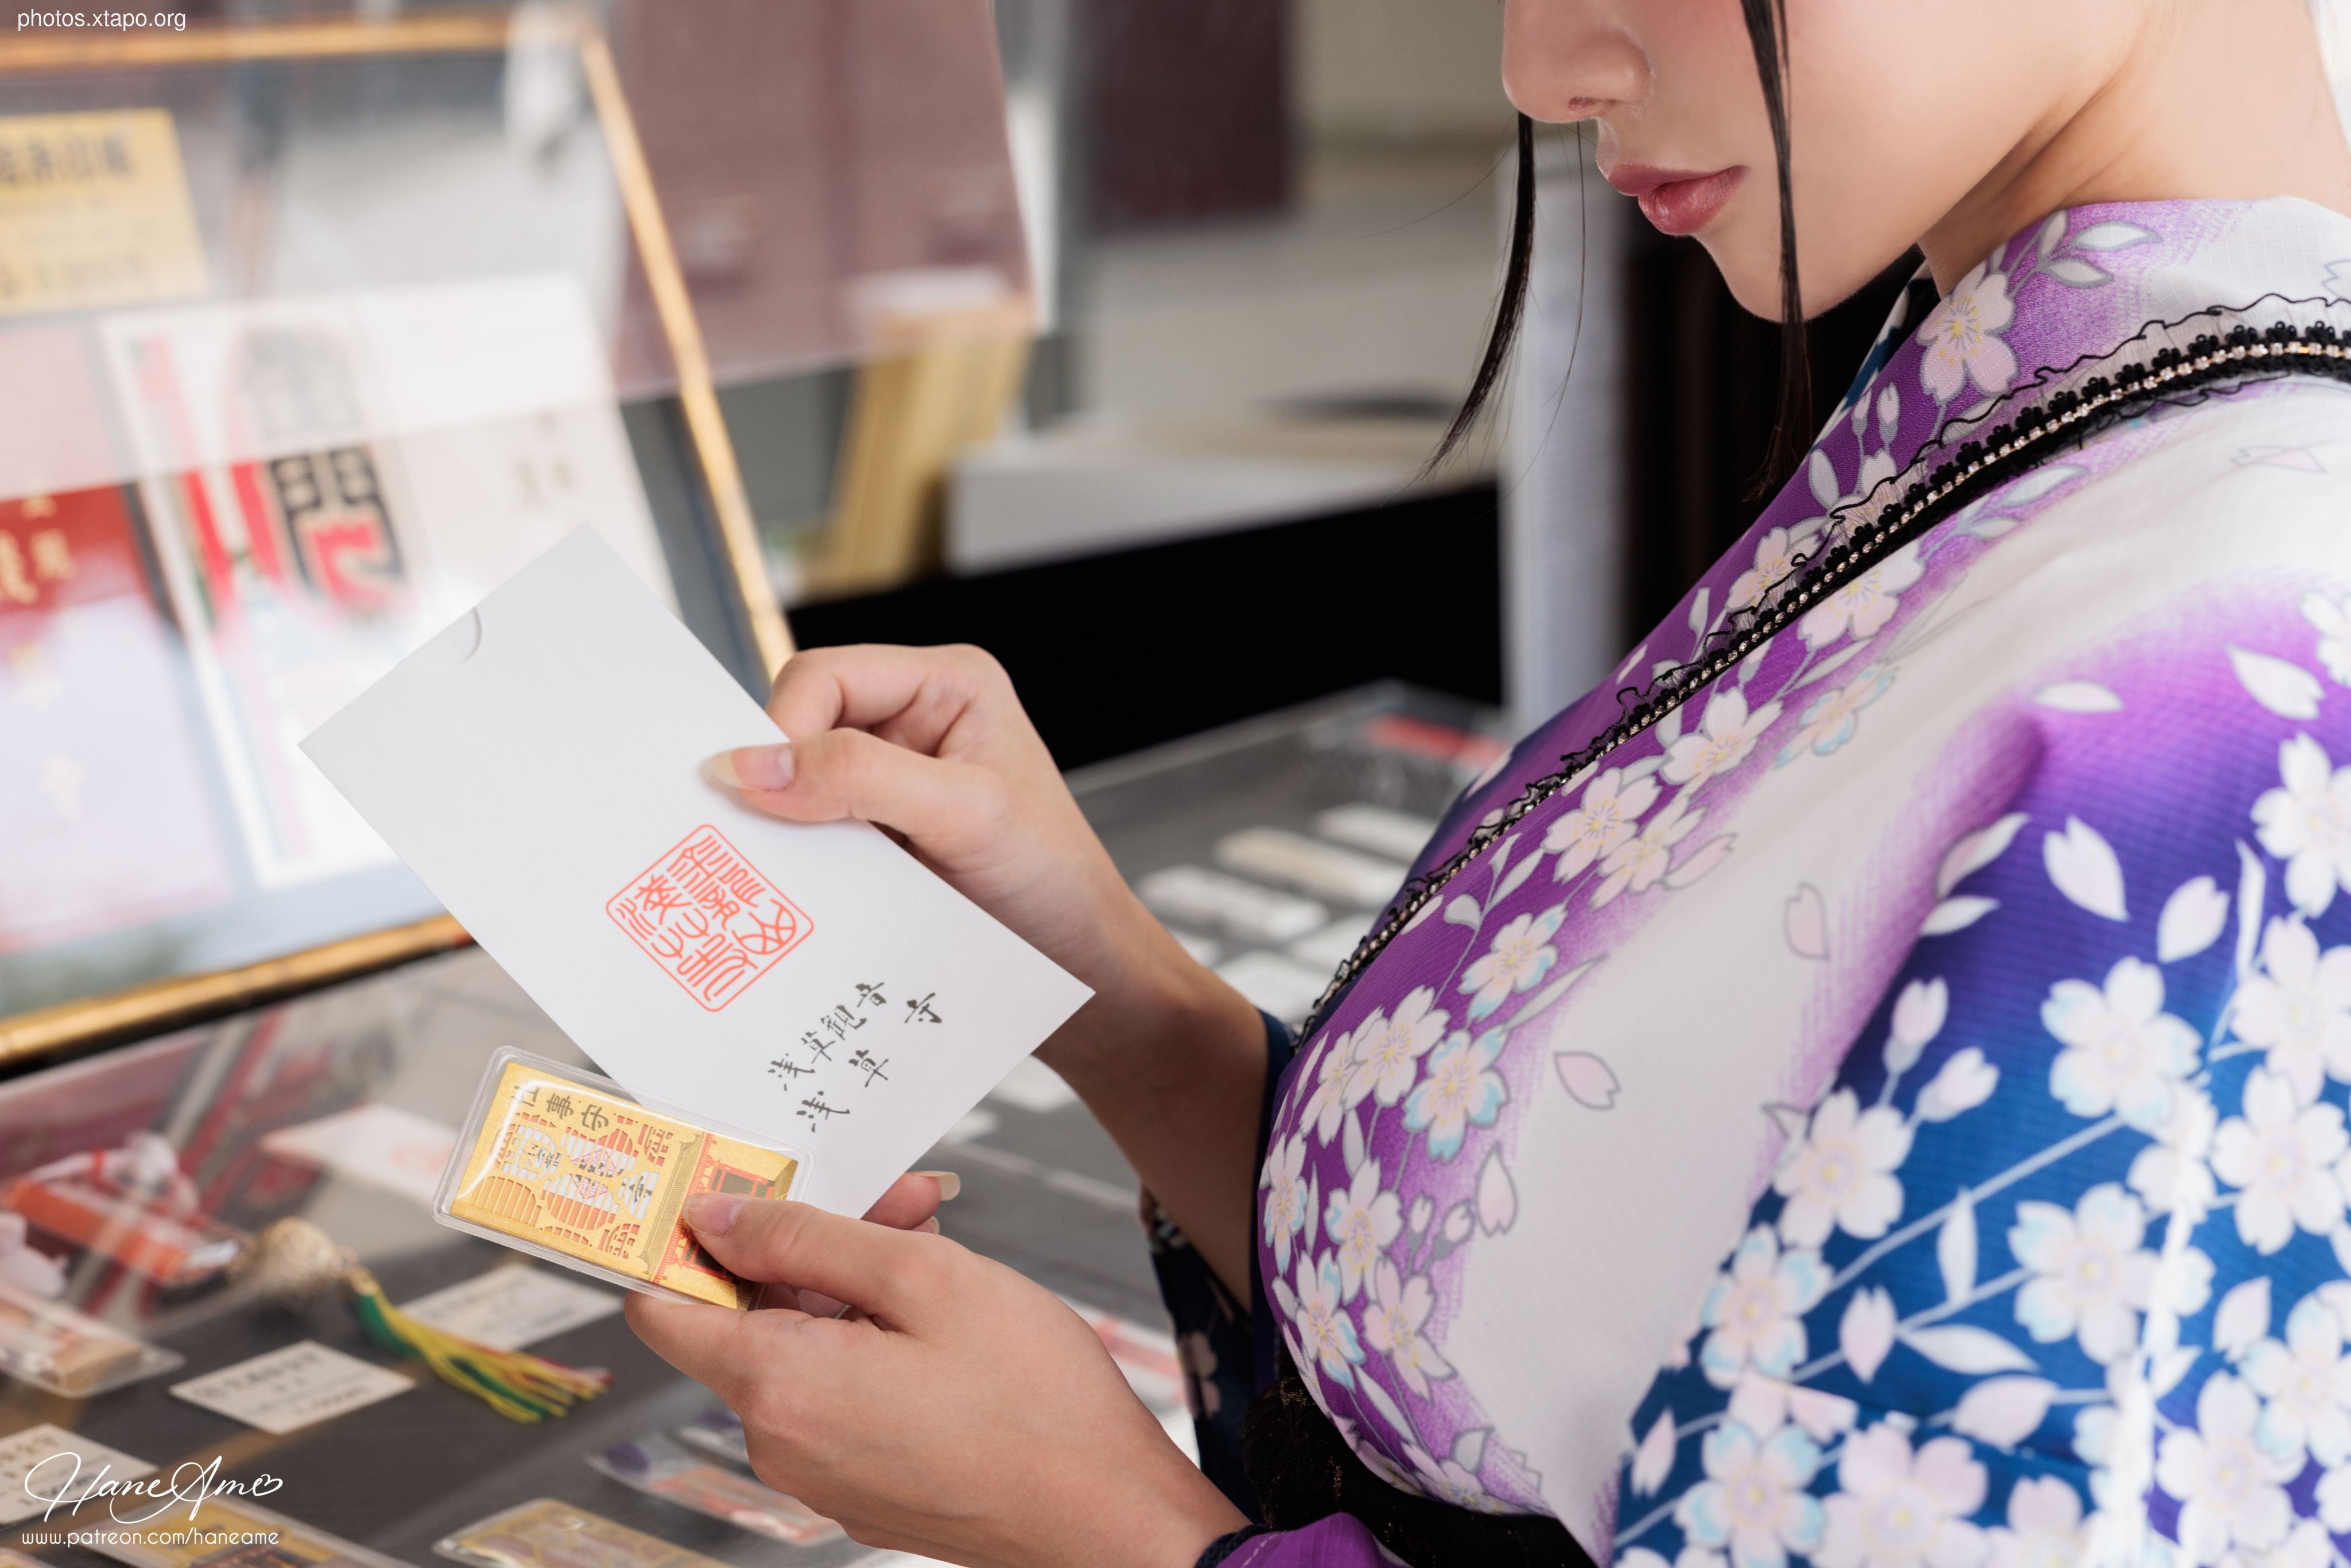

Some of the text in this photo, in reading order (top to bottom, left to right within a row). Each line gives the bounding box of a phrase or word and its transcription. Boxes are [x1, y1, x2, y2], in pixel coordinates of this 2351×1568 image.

[768, 982, 887, 1092] 浅草観音
[796, 992, 942, 1132] 浅草寺
[511, 1084, 609, 1131] 仕事守
